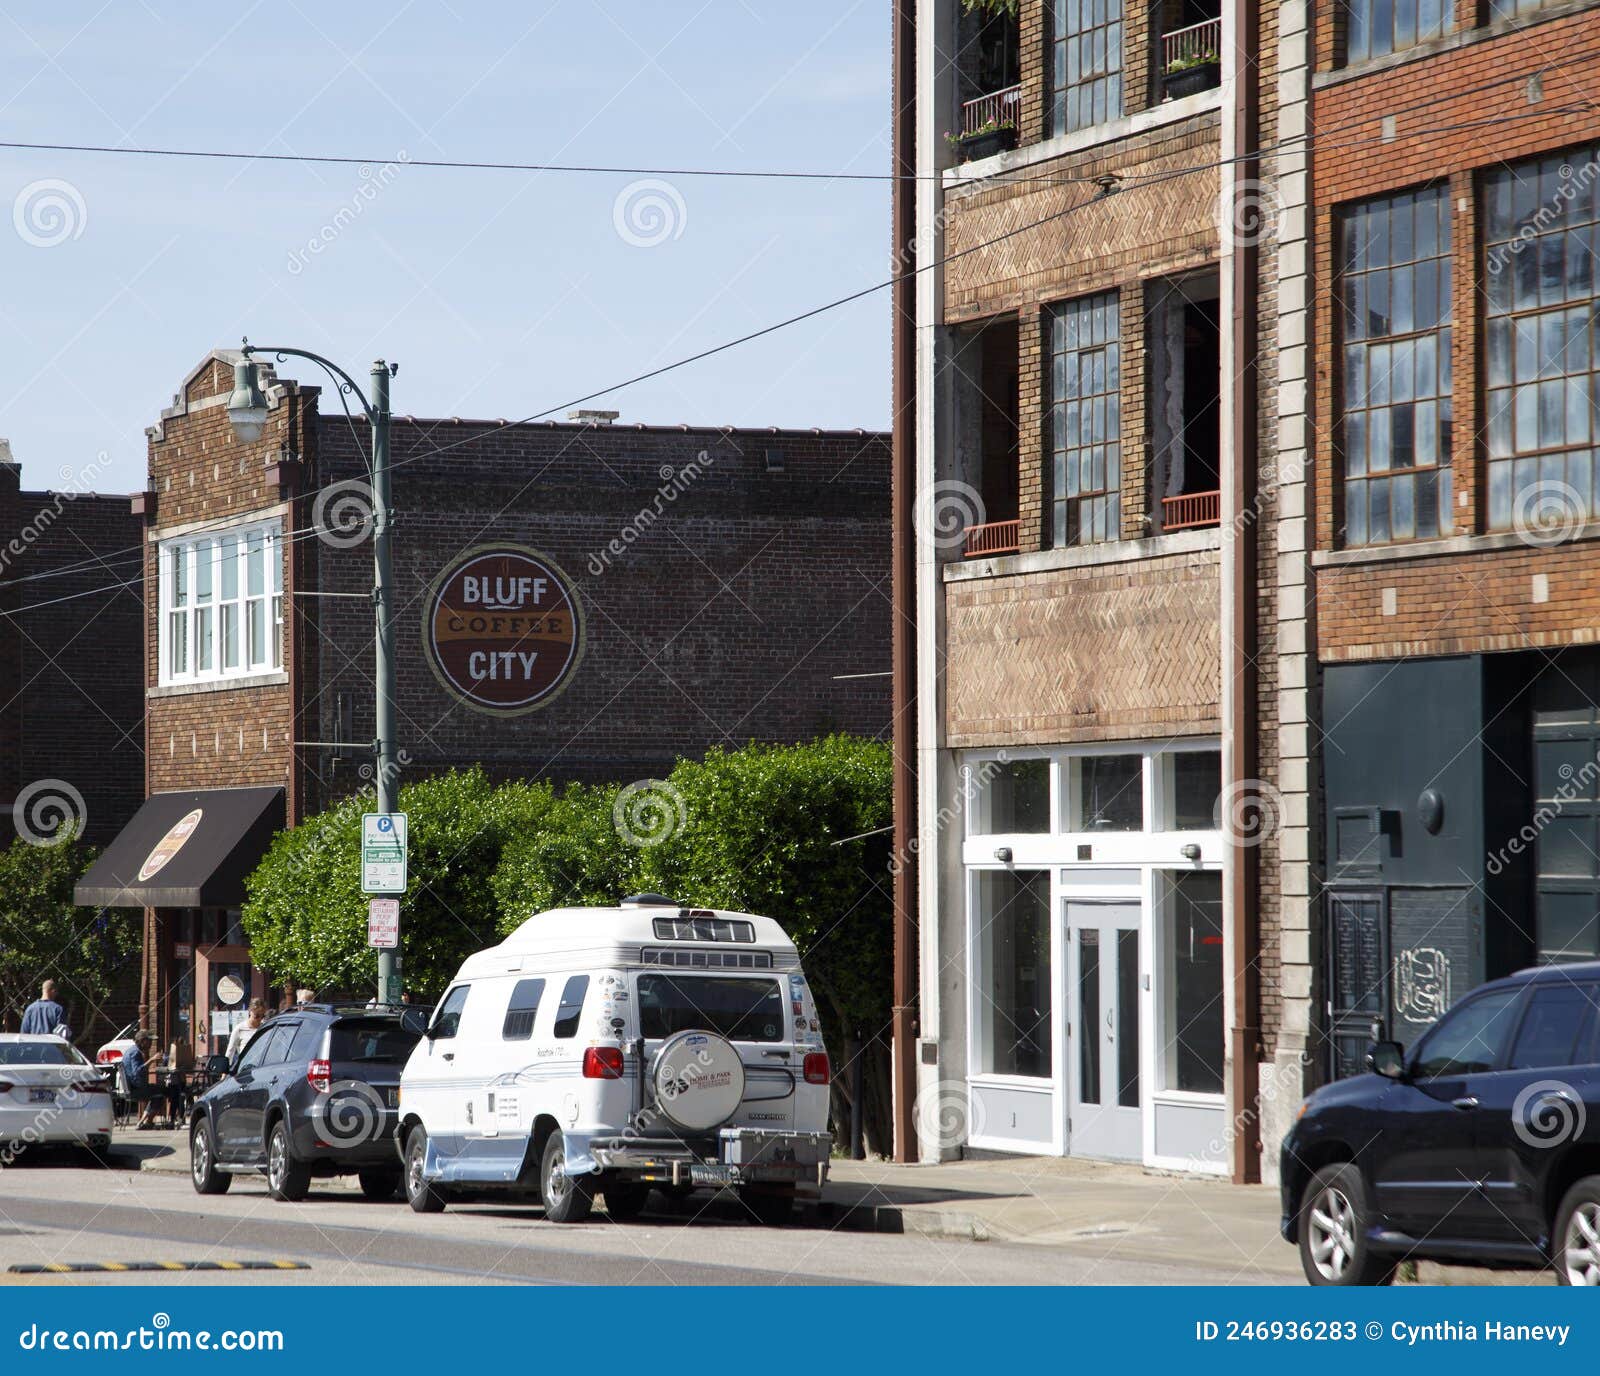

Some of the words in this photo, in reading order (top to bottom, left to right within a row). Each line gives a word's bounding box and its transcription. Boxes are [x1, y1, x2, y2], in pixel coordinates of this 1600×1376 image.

[463, 575, 547, 604] BLUFF
[448, 616, 562, 634] COFFEE
[469, 651, 538, 680] CITY
